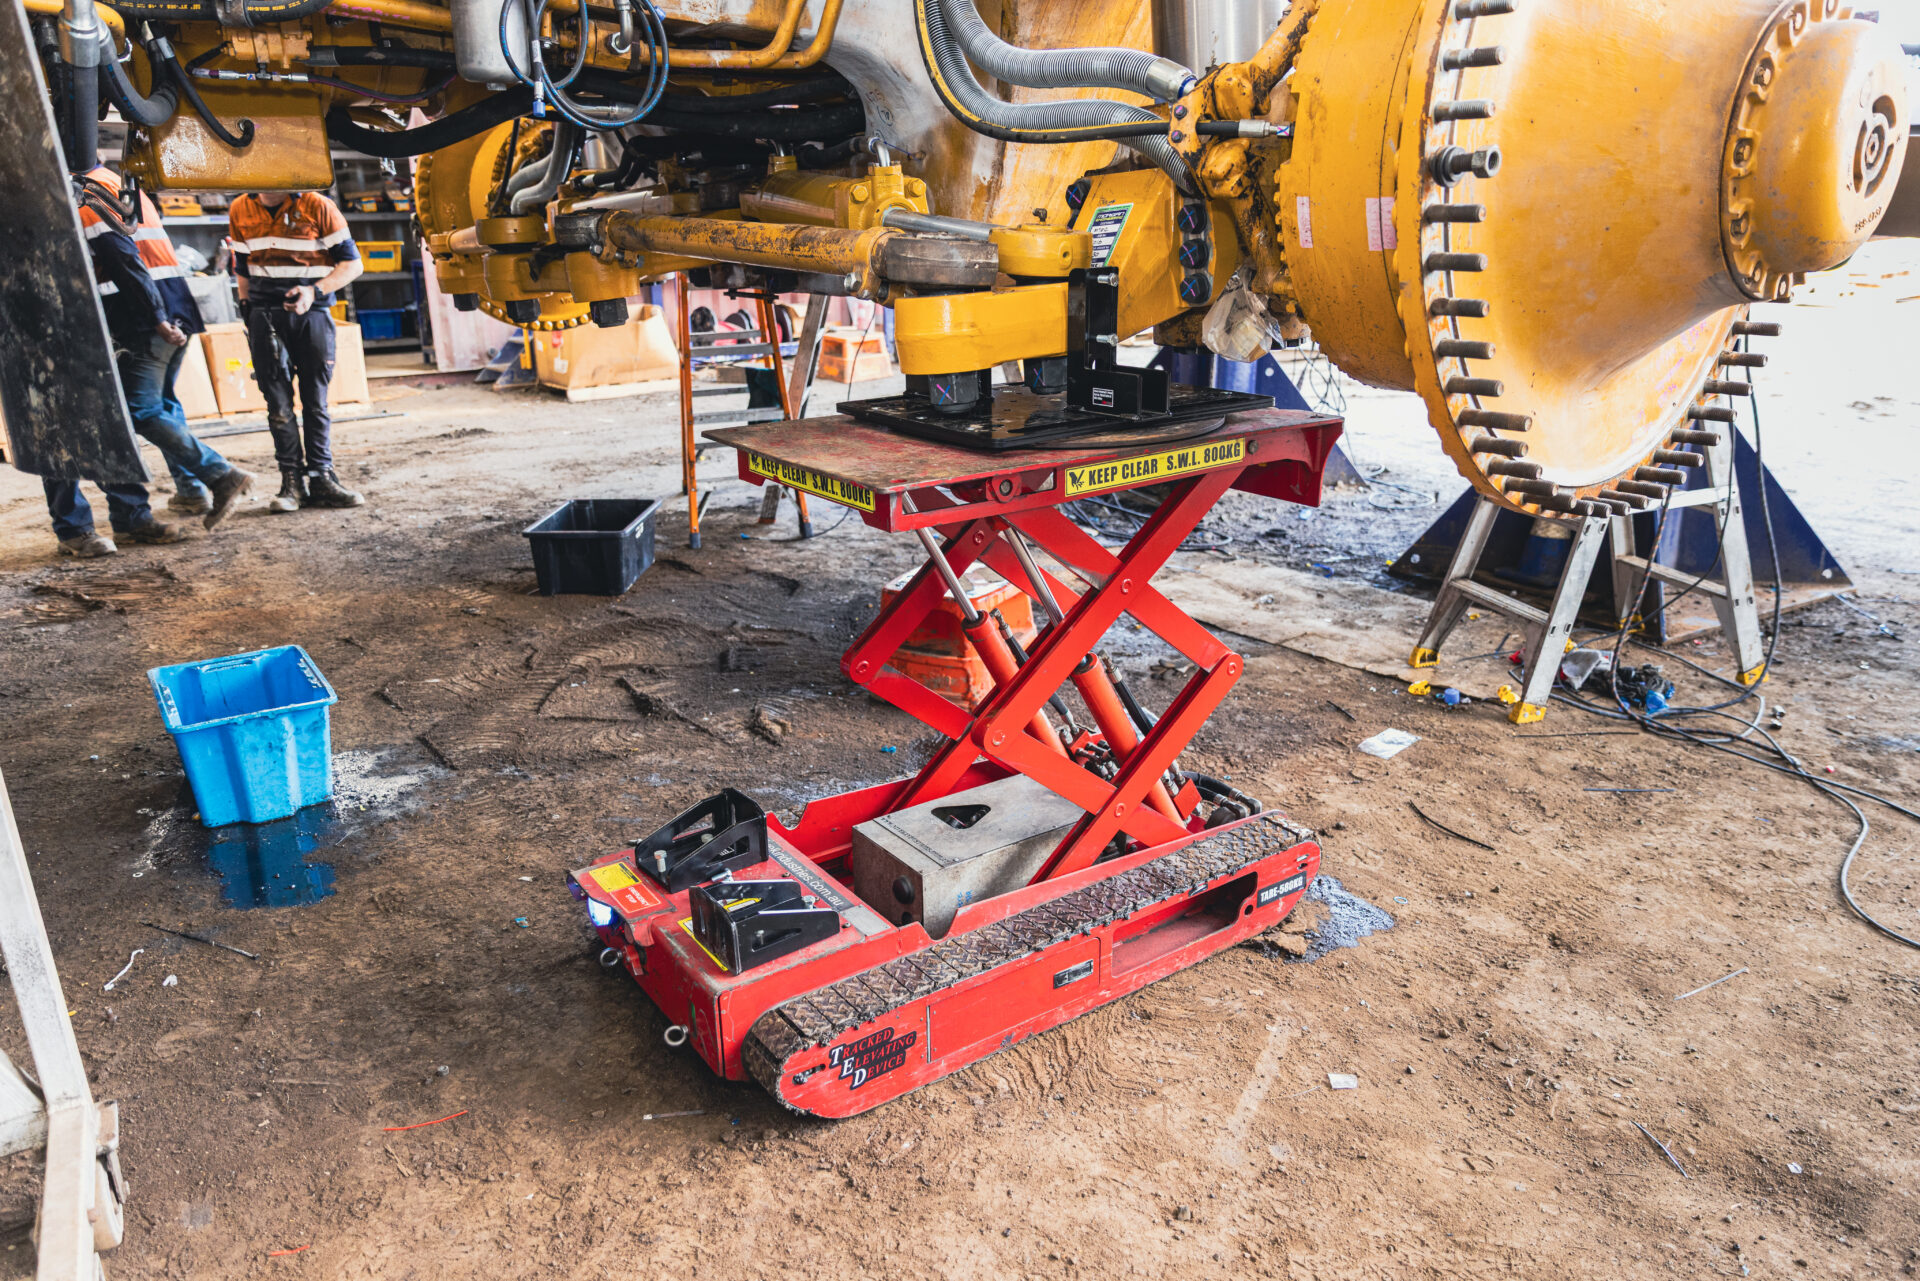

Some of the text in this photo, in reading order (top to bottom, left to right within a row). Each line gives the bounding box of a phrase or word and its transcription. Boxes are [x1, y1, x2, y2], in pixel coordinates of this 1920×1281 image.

[761, 458, 871, 506] KEEP CLEAR S.W.L. 800KG
[1088, 442, 1241, 486] KEEP CLEAR S.W.L. 800KG
[831, 1029, 892, 1066] TRACKED
[840, 1033, 914, 1078] ELEVATING
[852, 1053, 904, 1088] DEVICE
